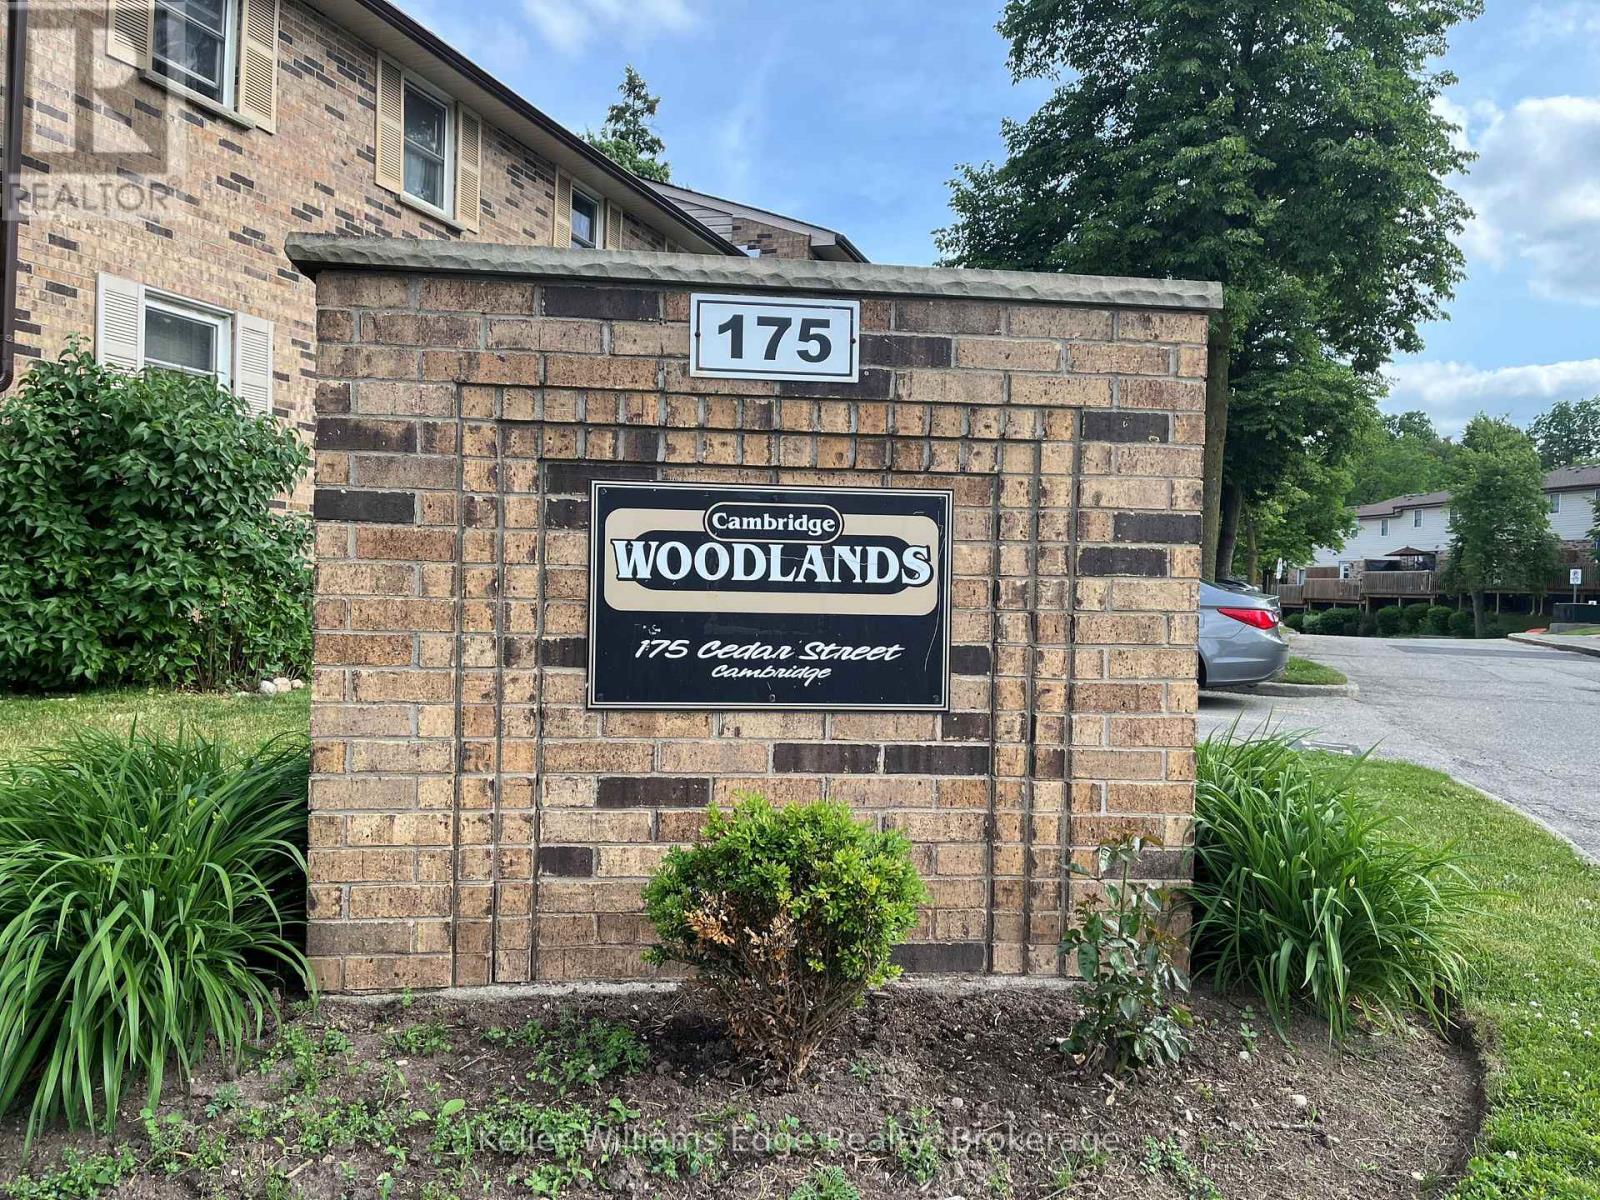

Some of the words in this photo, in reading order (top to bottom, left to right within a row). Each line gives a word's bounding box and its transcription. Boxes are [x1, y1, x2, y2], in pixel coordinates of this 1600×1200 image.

[718, 314, 832, 363] 175
[712, 512, 836, 536] Cambridge
[611, 540, 934, 585] WOODLANDS
[635, 639, 690, 659] 175
[697, 640, 794, 660] Cedar
[798, 641, 905, 661] Street
[711, 664, 832, 687] Cambridge
